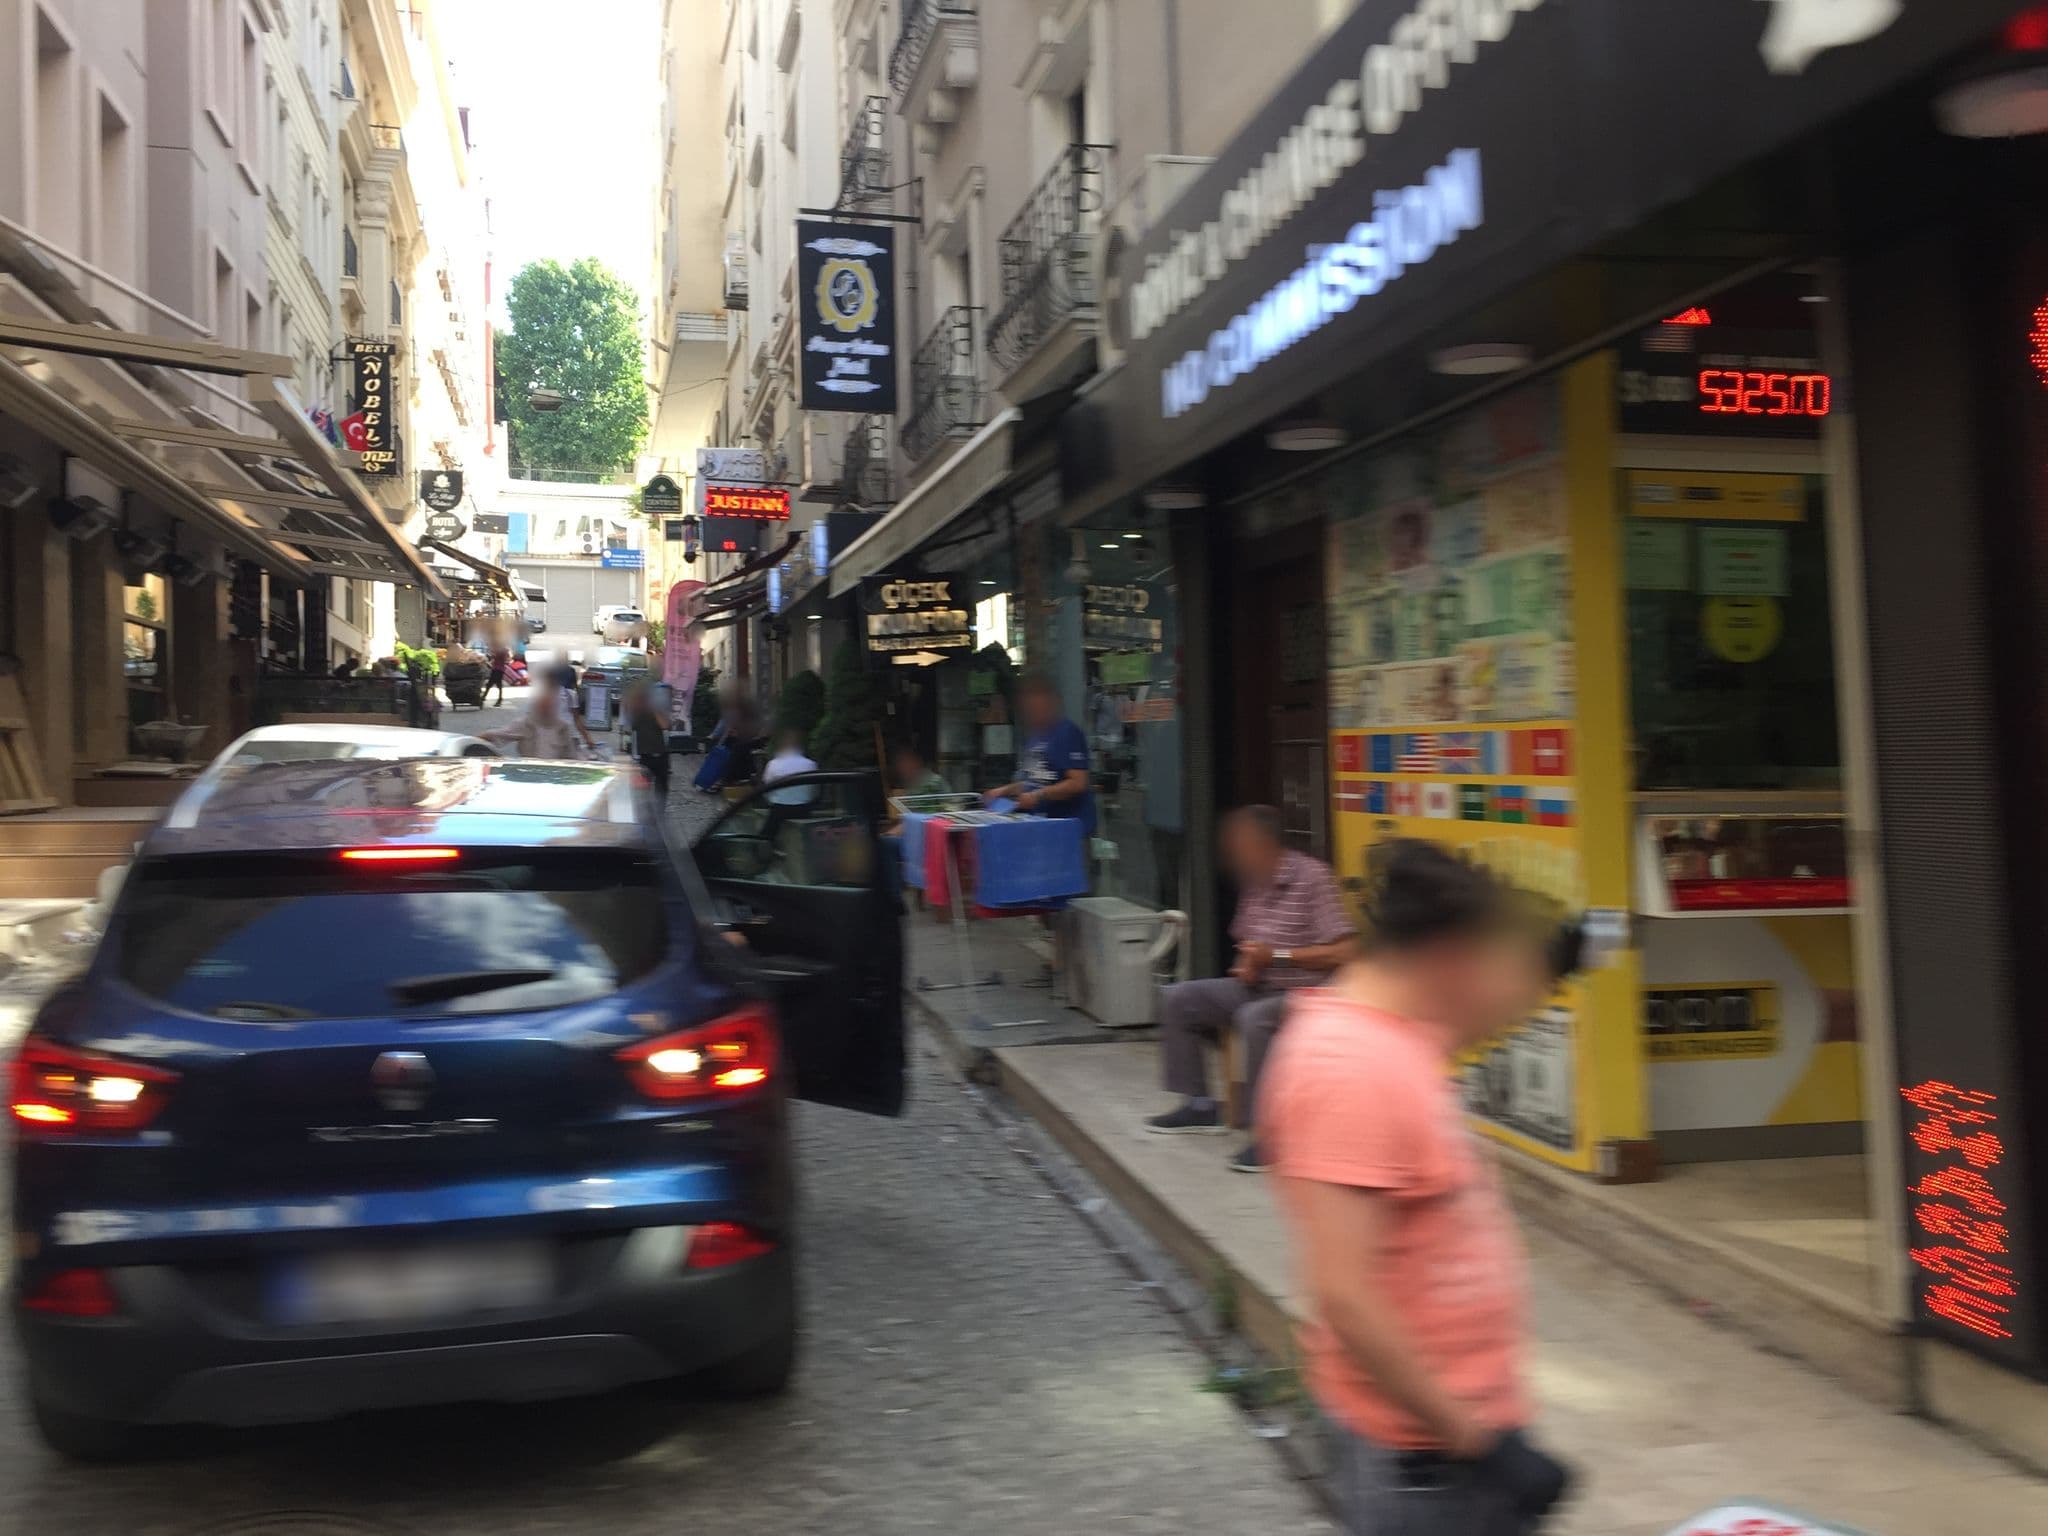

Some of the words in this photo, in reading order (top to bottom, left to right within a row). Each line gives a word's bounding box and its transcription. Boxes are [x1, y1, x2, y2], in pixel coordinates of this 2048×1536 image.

[354, 344, 390, 353] BEST
[362, 361, 383, 442] NOBEL
[431, 517, 457, 527] HOTEL
